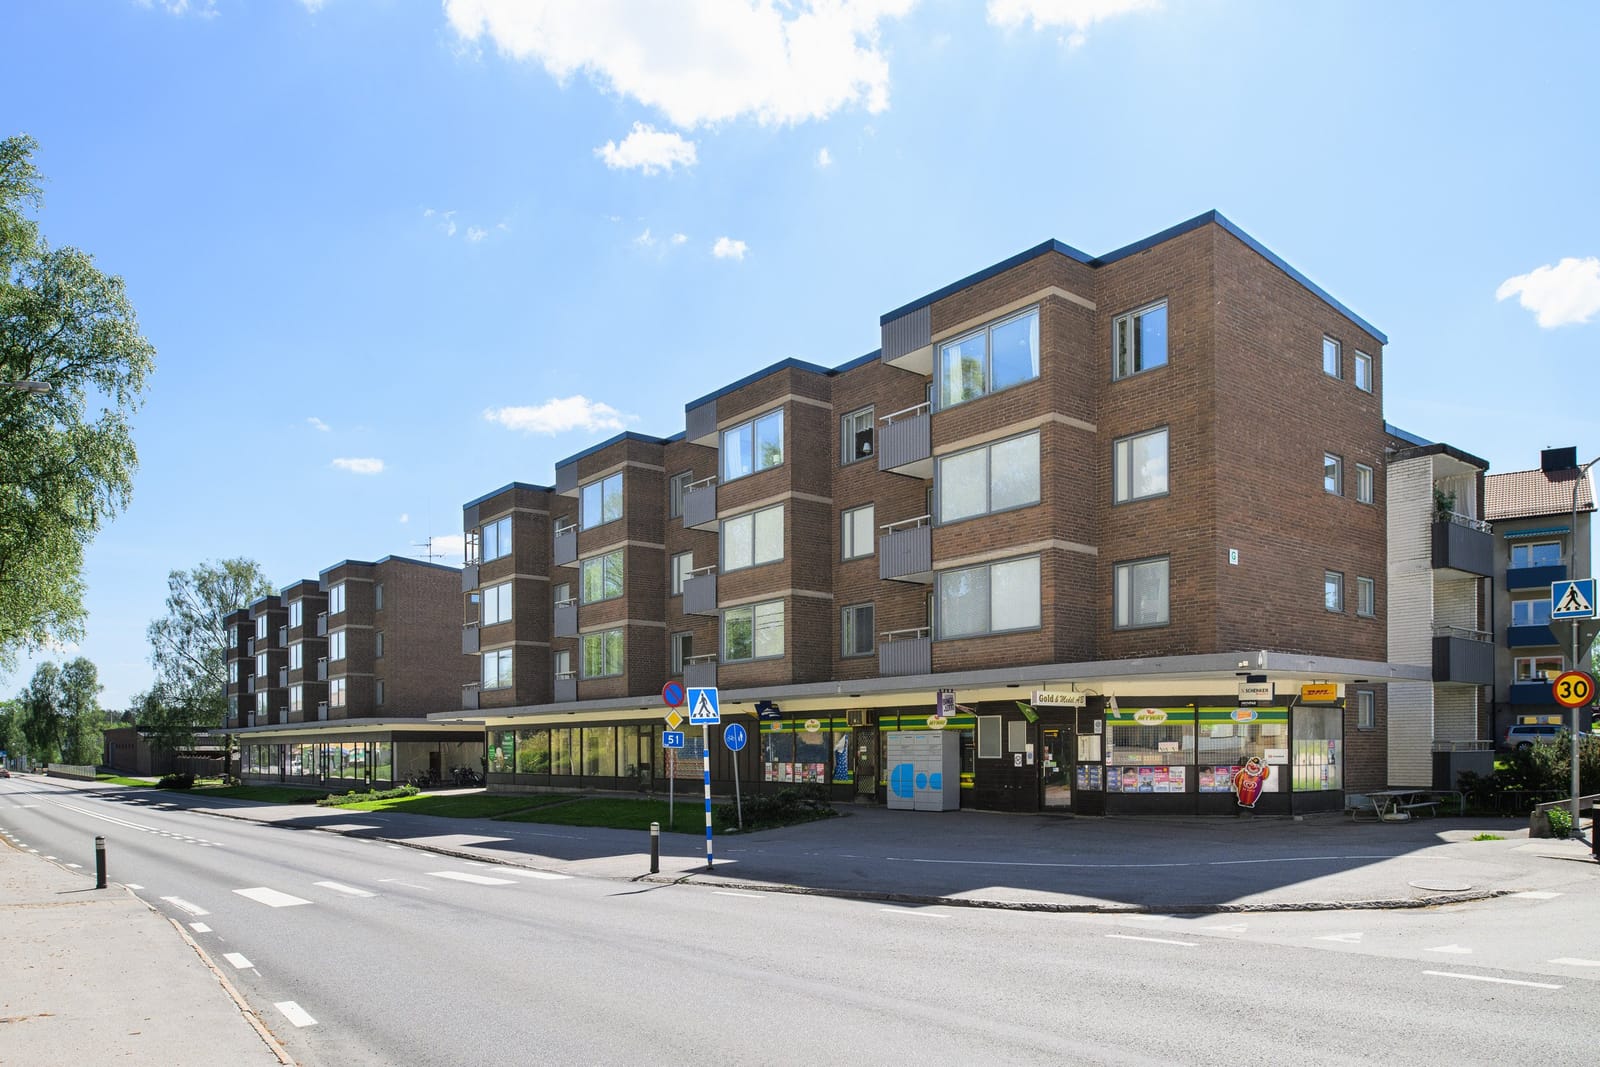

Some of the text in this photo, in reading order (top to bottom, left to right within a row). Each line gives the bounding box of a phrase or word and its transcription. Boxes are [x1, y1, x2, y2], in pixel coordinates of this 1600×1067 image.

[1560, 681, 1587, 698] 30
[1039, 694, 1054, 703] Gold
[668, 735, 679, 745] 51
